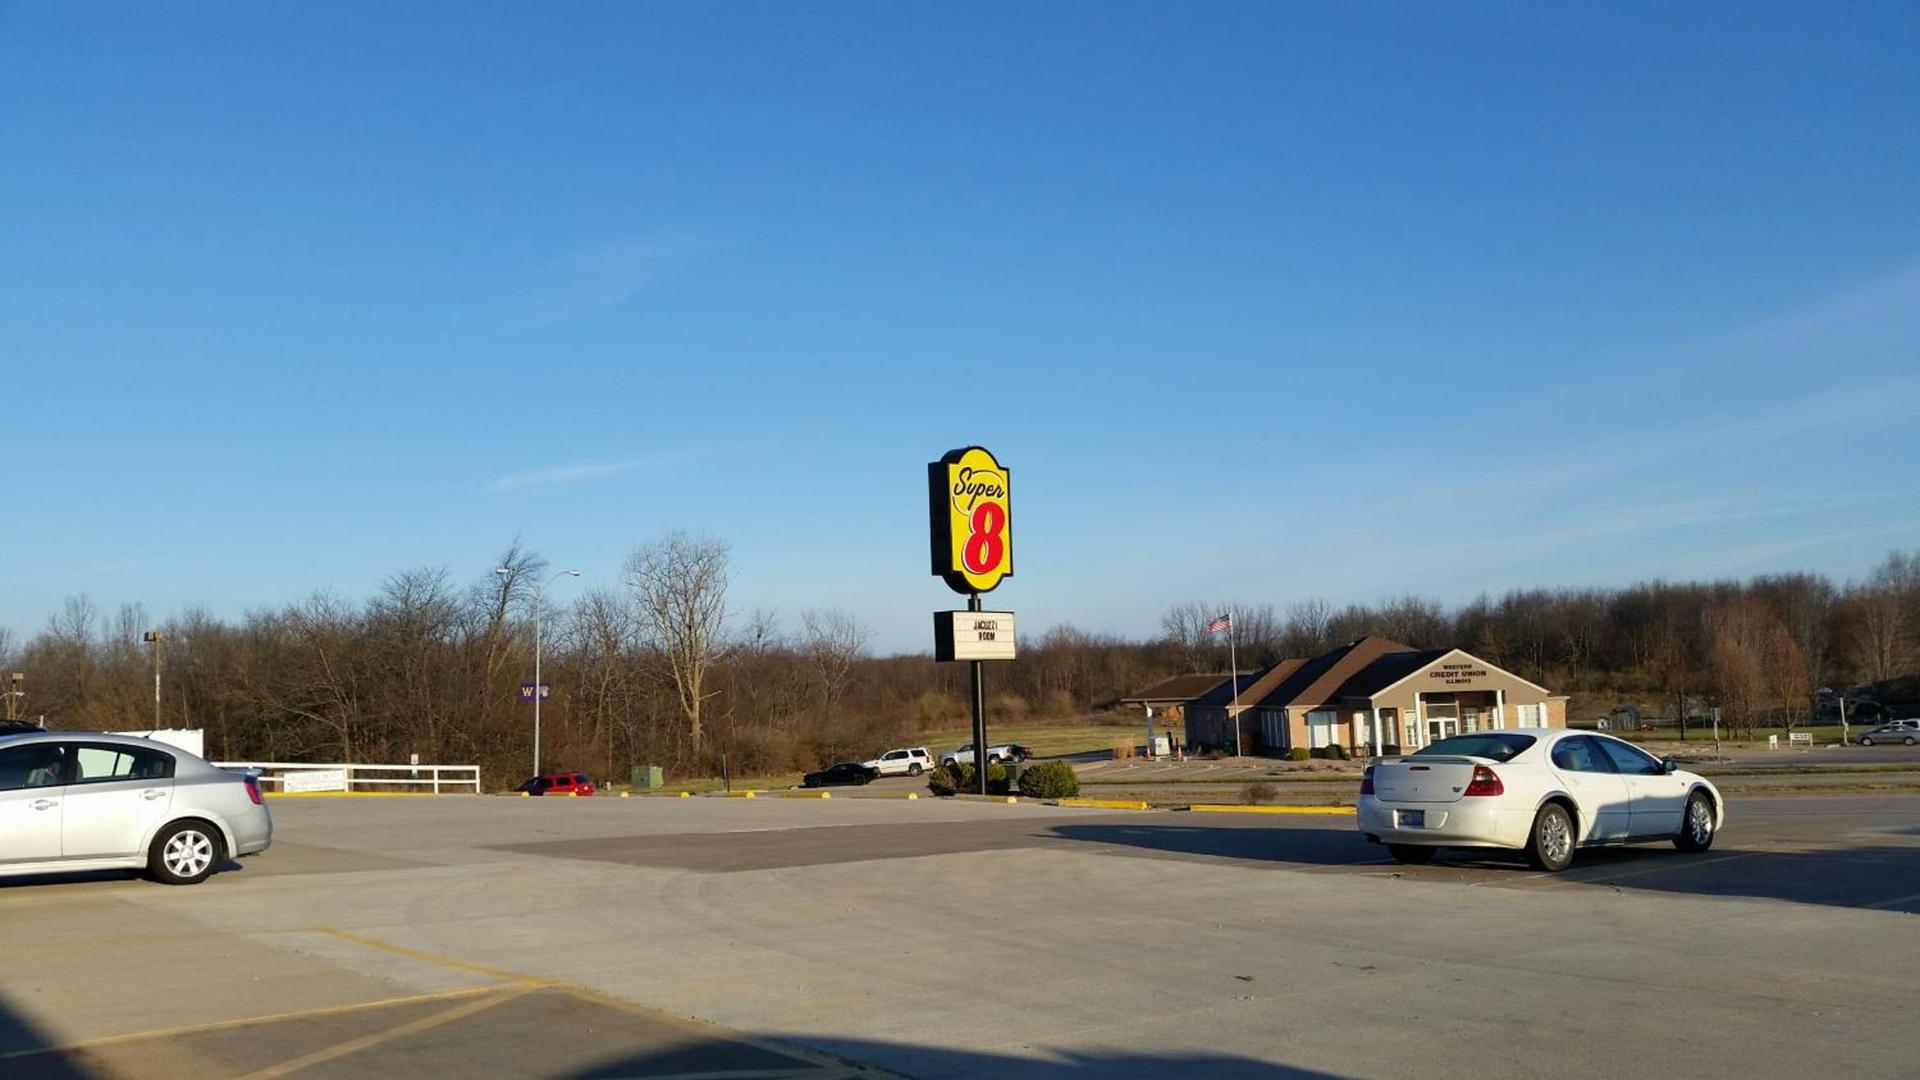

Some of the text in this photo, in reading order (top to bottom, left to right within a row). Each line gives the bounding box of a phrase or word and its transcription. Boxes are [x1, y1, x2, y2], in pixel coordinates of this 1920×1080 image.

[953, 466, 1004, 511] Super
[962, 501, 1005, 575] 8
[974, 621, 998, 630] JACUZZI
[979, 632, 996, 641] ROOM
